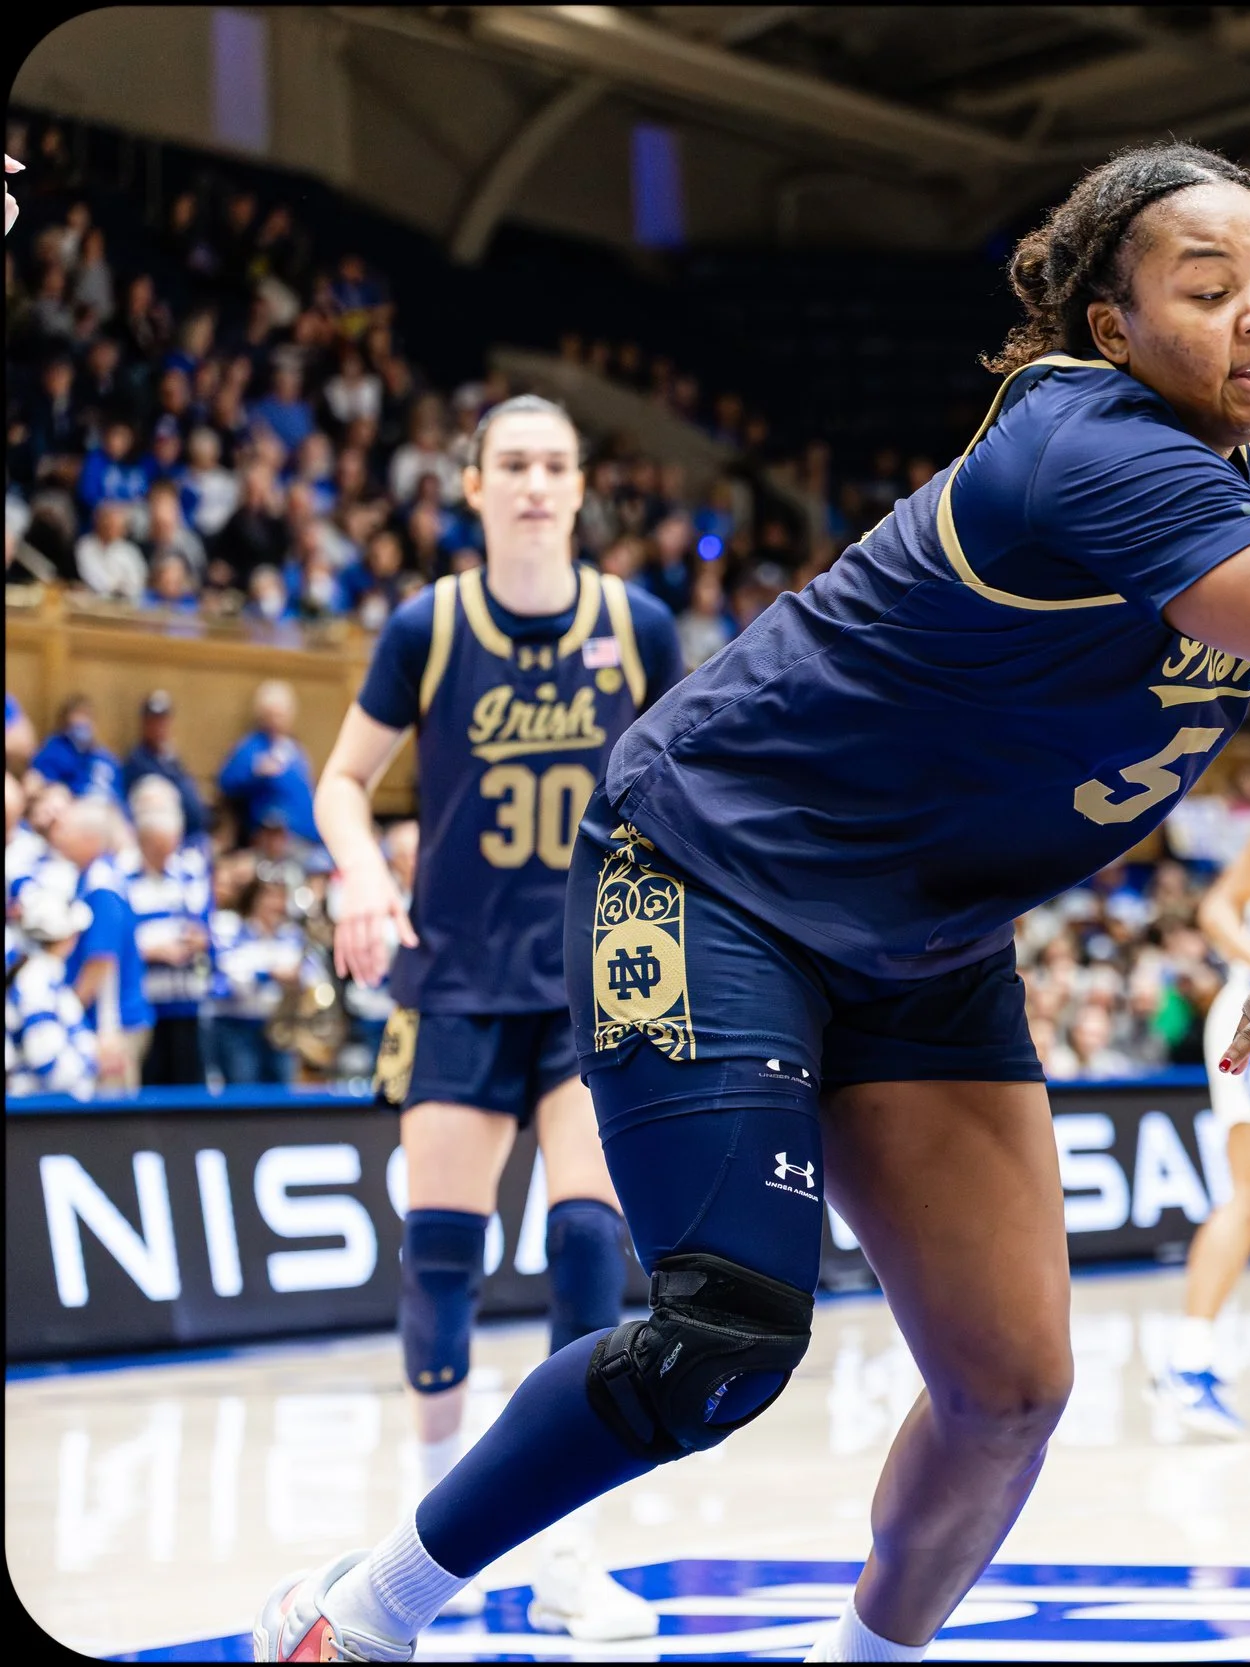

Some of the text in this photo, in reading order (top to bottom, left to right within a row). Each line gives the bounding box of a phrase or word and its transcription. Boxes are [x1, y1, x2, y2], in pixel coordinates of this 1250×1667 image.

[467, 682, 607, 744] Irish
[1073, 727, 1225, 825] 5
[479, 763, 597, 871] 30
[765, 1180, 793, 1193] UNDER
